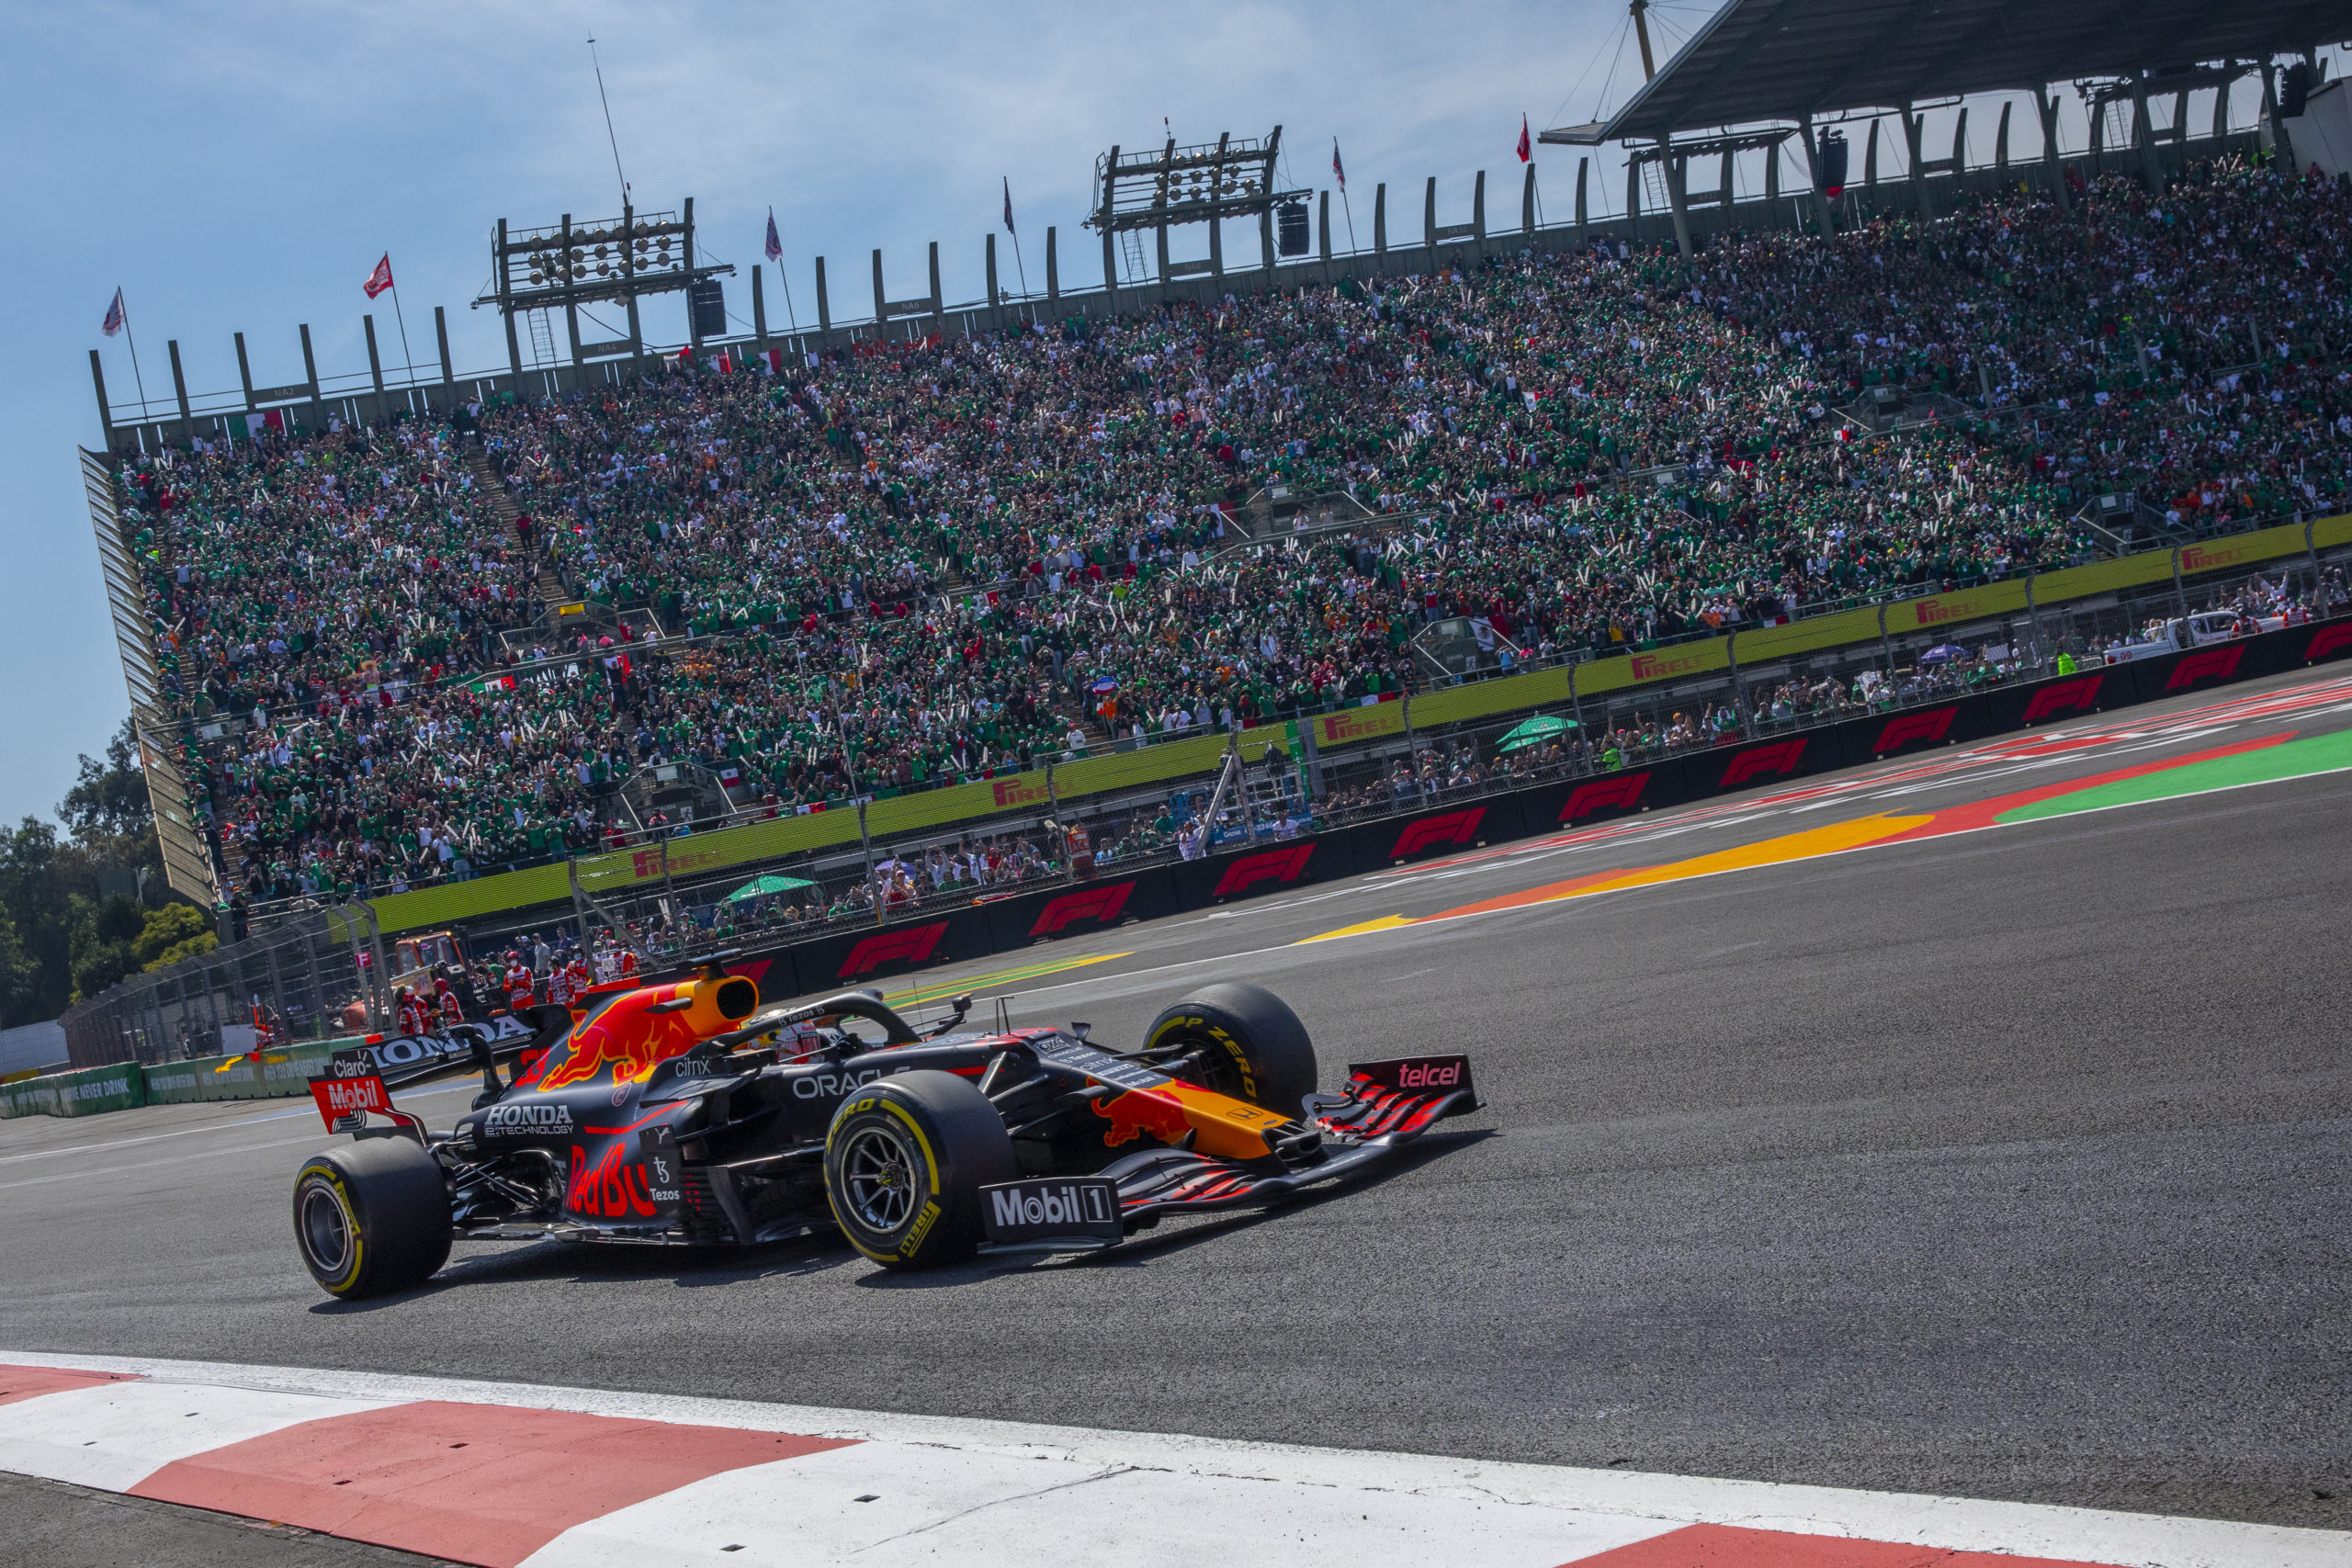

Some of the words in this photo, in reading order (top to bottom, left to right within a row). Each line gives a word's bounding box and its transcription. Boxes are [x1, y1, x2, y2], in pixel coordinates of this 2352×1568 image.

[902, 302, 919, 310] NA6
[598, 344, 616, 353] NA4
[274, 388, 294, 397] NA2
[2120, 651, 2133, 660] 09
[359, 953, 368, 965] F
[788, 1010, 815, 1023] Tezos
[334, 1059, 367, 1078] Claro
[675, 1055, 712, 1077] citrix
[1207, 1025, 1258, 1098] ZERO
[792, 1066, 911, 1100] ORAC
[1398, 1061, 1462, 1088] telcel
[79, 1082, 103, 1100] NEVER
[103, 1077, 130, 1097] DRINK
[328, 1081, 379, 1111] Mobil
[484, 1104, 573, 1125] HONDA
[650, 1188, 680, 1201] Tezos
[991, 1184, 1081, 1226] Mobil
